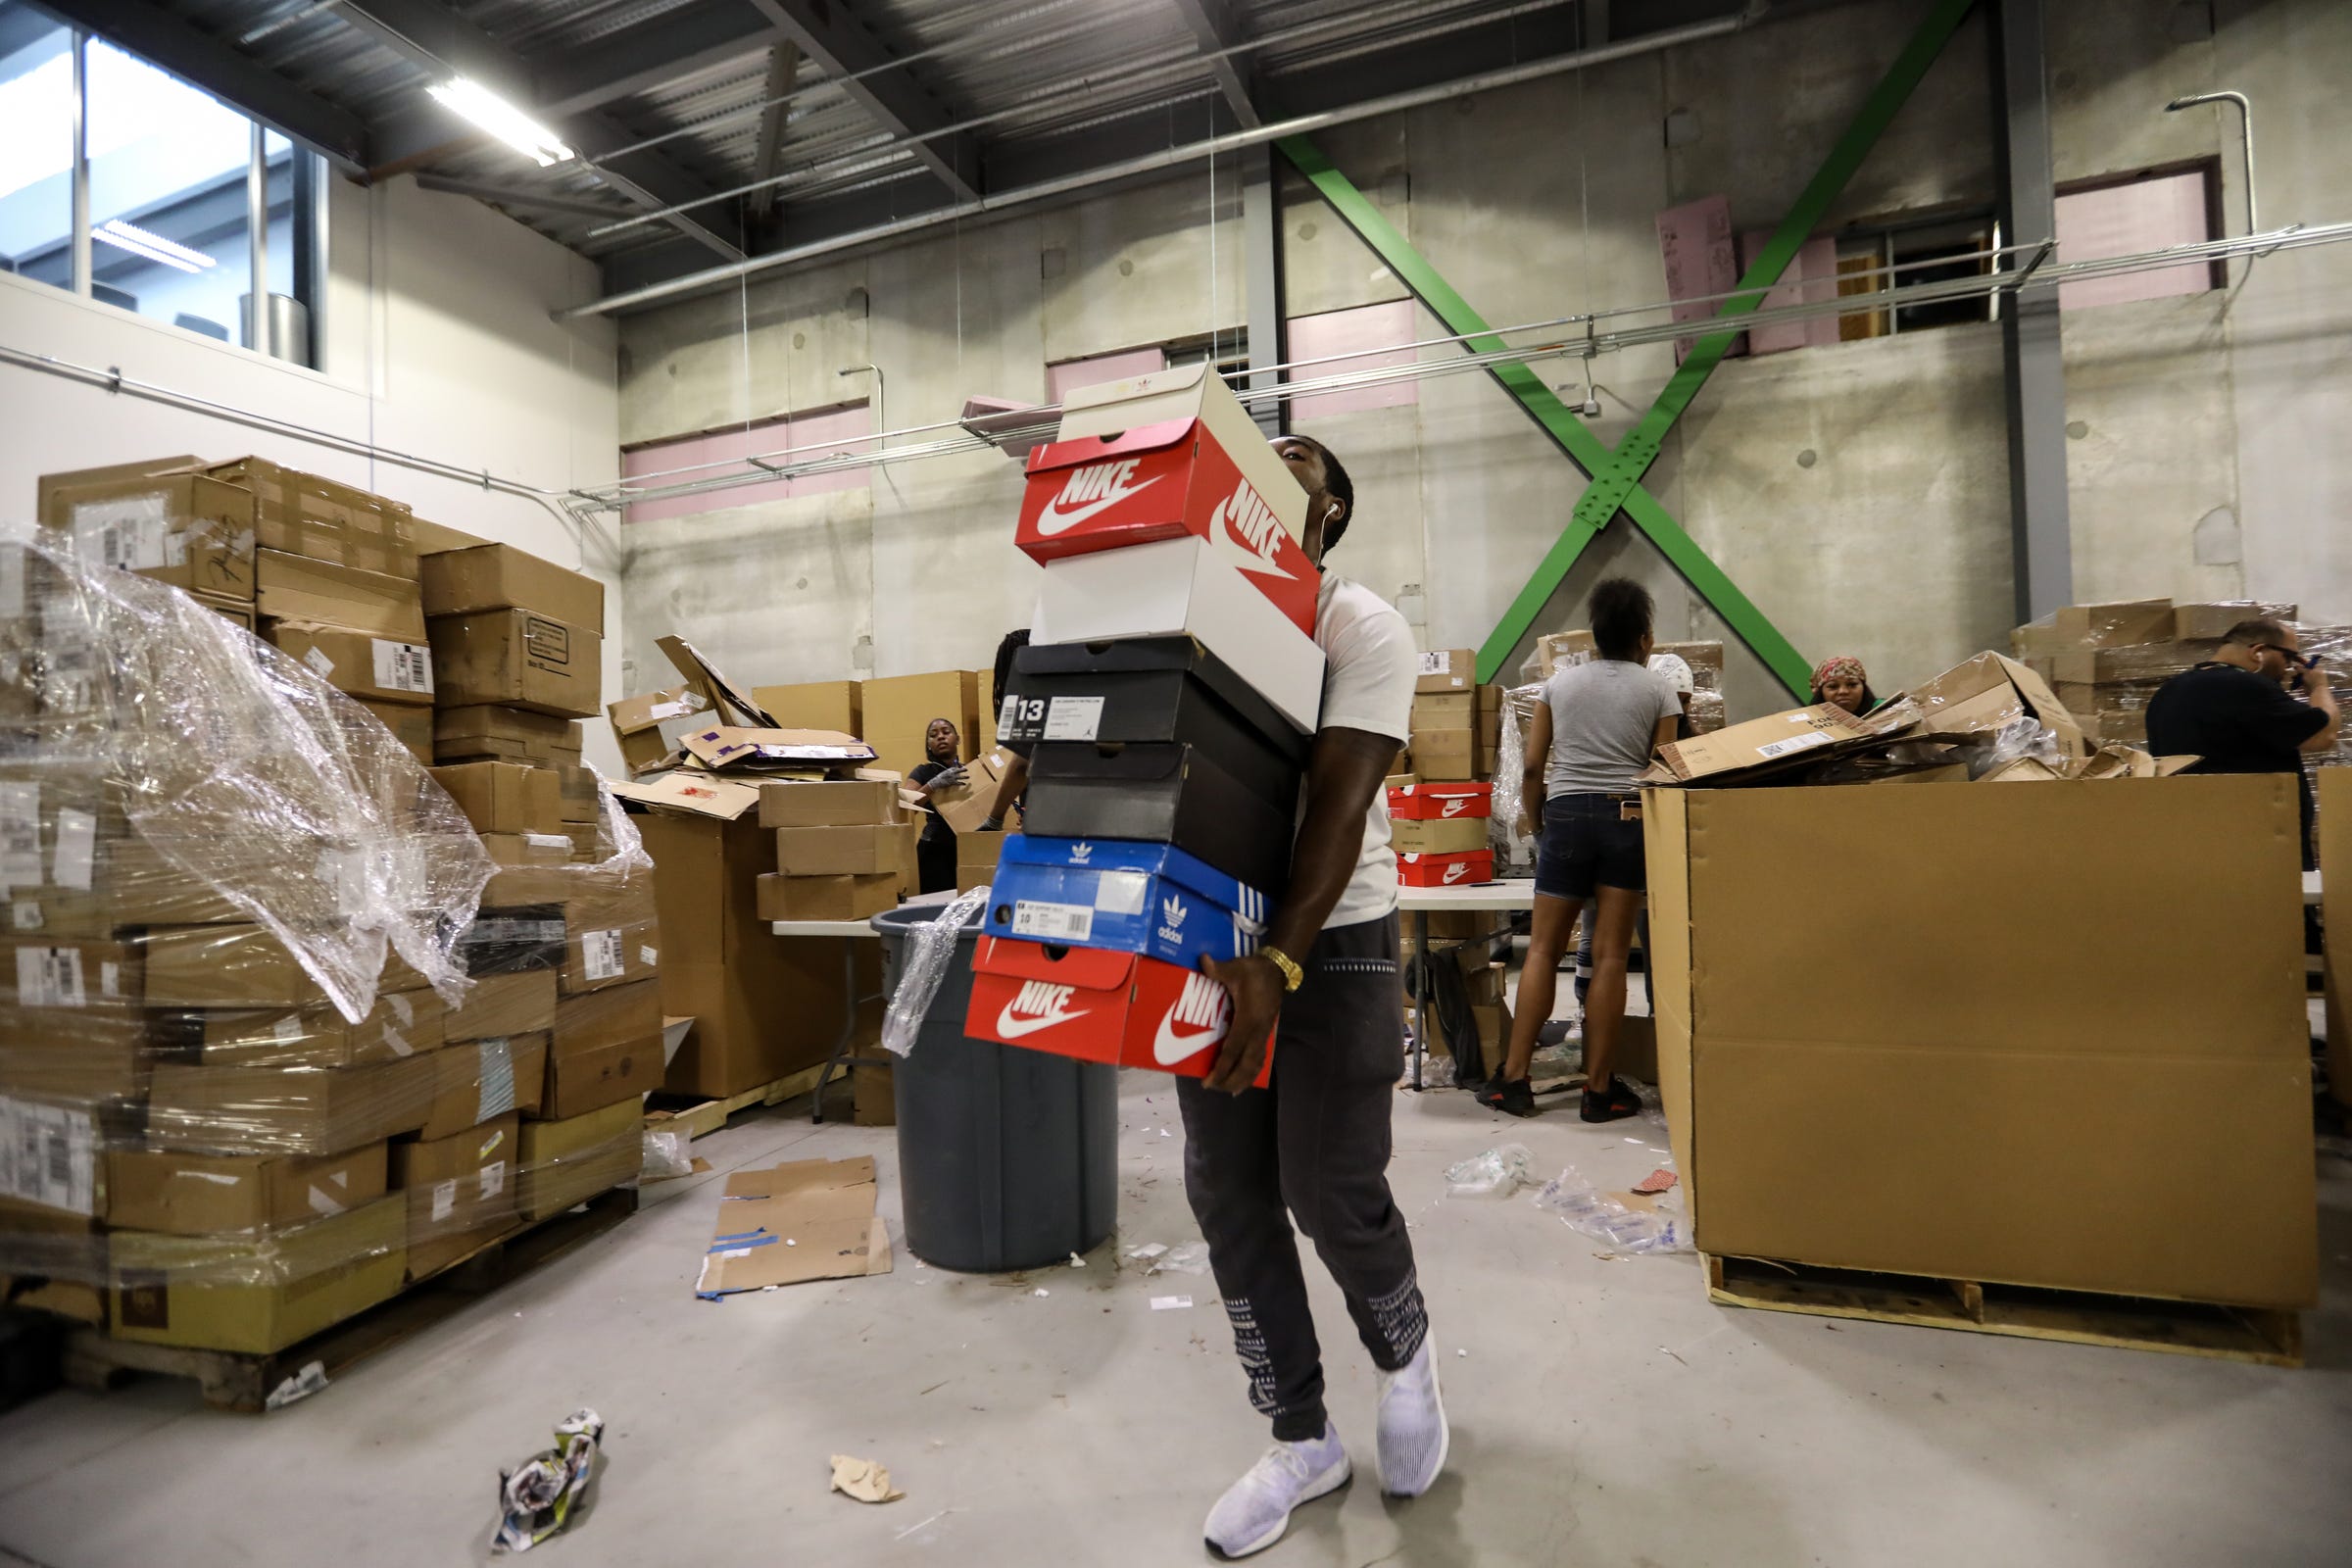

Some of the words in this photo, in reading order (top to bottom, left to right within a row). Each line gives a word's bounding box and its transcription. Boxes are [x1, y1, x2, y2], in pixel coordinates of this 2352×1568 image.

[1057, 458, 1141, 505] NIKE
[1225, 476, 1287, 566] NIKE
[1018, 699, 1045, 721] 13
[1158, 926, 1183, 945] adidas
[1011, 979, 1076, 1018] NIKE
